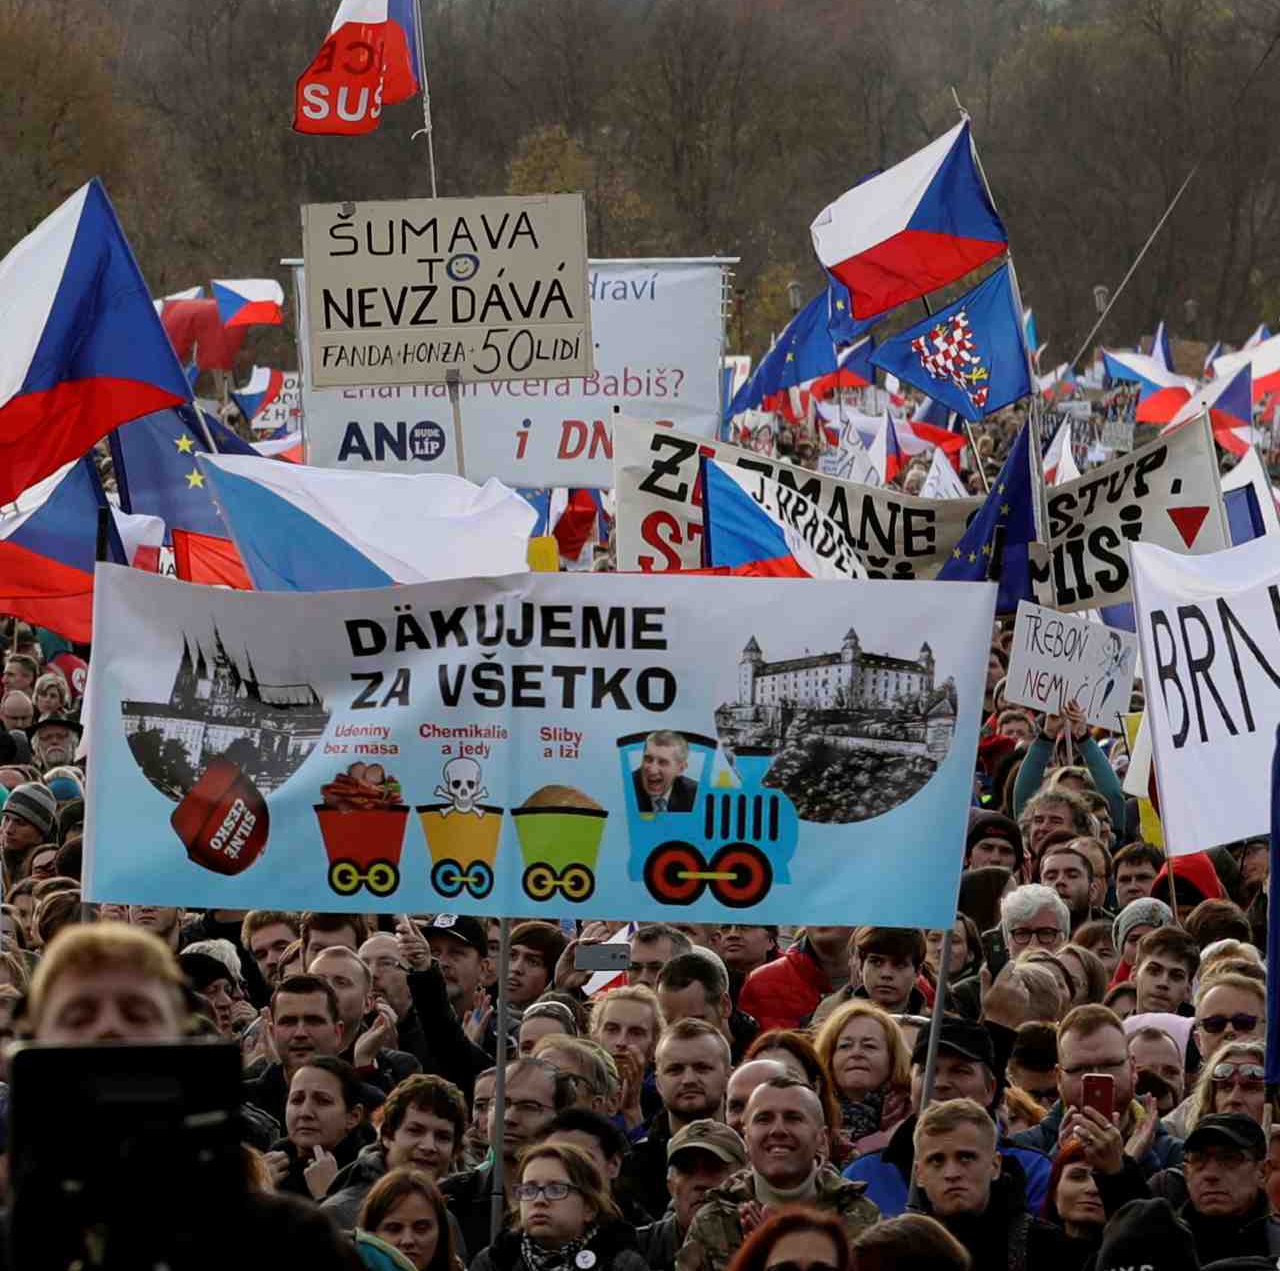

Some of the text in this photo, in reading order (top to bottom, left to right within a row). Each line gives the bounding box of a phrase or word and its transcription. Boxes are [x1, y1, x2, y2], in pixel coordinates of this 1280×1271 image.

[330, 212, 539, 256] ŠUMAVA
[322, 329, 583, 375] FANDA HONZA 50 LIDÍ
[583, 367, 685, 398] Babiš?
[415, 437, 440, 455] LÍP
[516, 418, 532, 459] i
[350, 651, 677, 713] ZA VŠETKO
[442, 742, 492, 759] a jedy
[540, 726, 583, 746] Sliby
[544, 749, 553, 759] a
